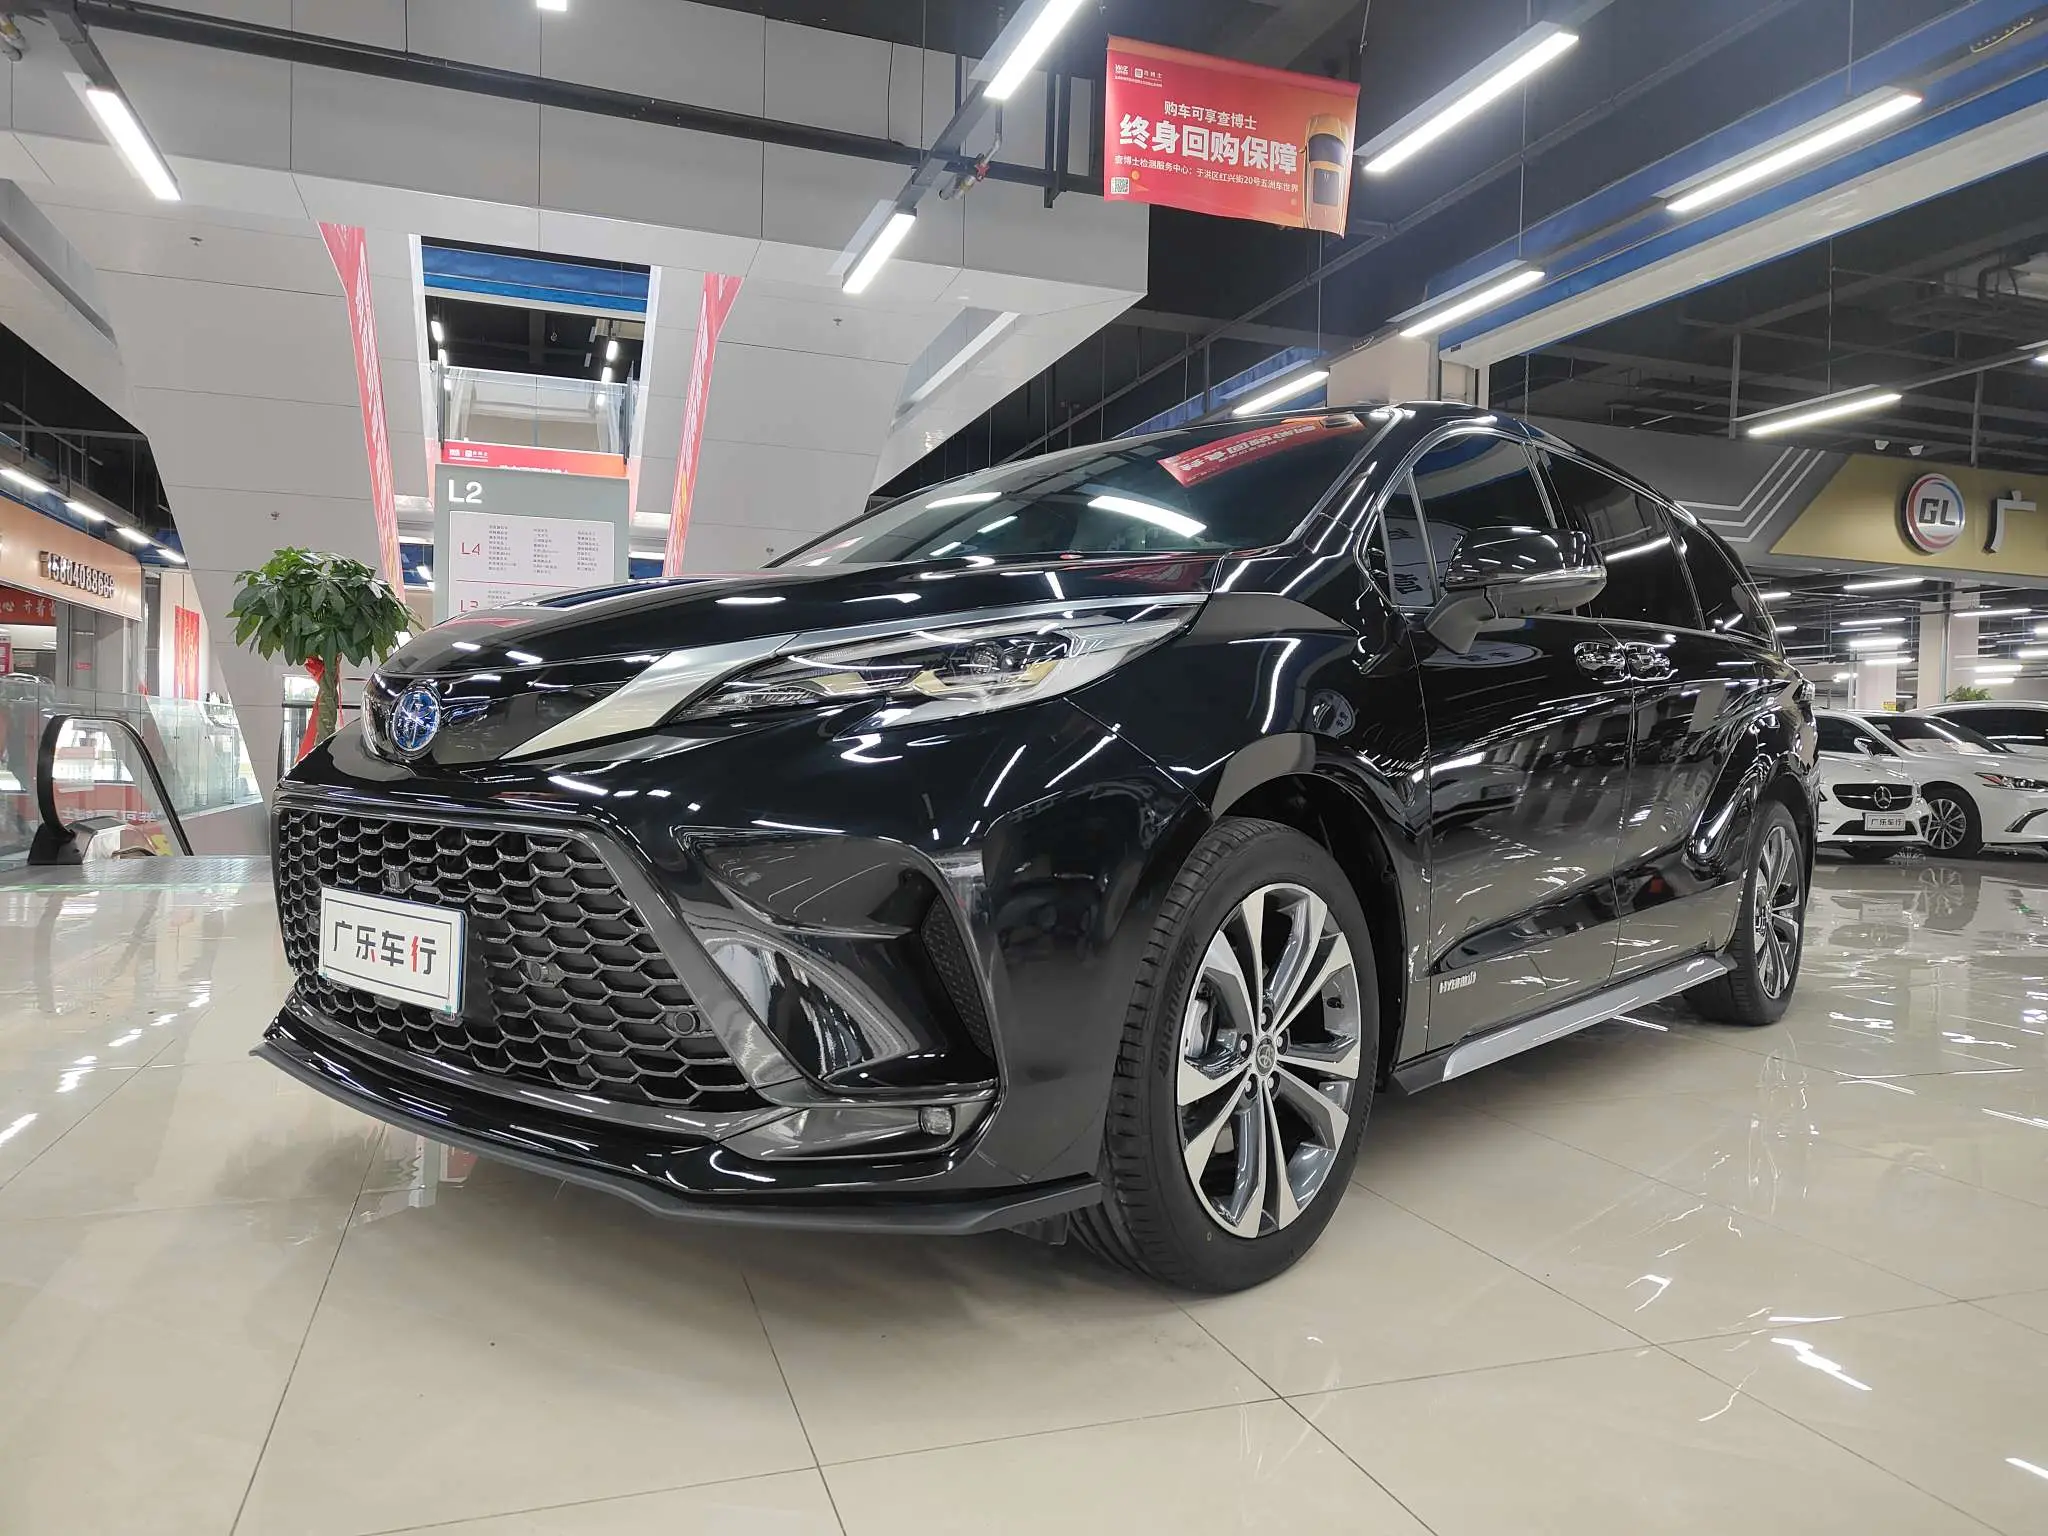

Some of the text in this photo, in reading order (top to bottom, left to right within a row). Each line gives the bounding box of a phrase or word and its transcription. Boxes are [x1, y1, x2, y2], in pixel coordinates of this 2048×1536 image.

[1164, 100, 1257, 131] 购车可享查博士
[1119, 113, 1298, 175] 终身回购保障
[448, 479, 483, 504] L2
[1919, 497, 1956, 526] GL
[461, 542, 481, 555] L4
[333, 920, 437, 975] 广乐车行
